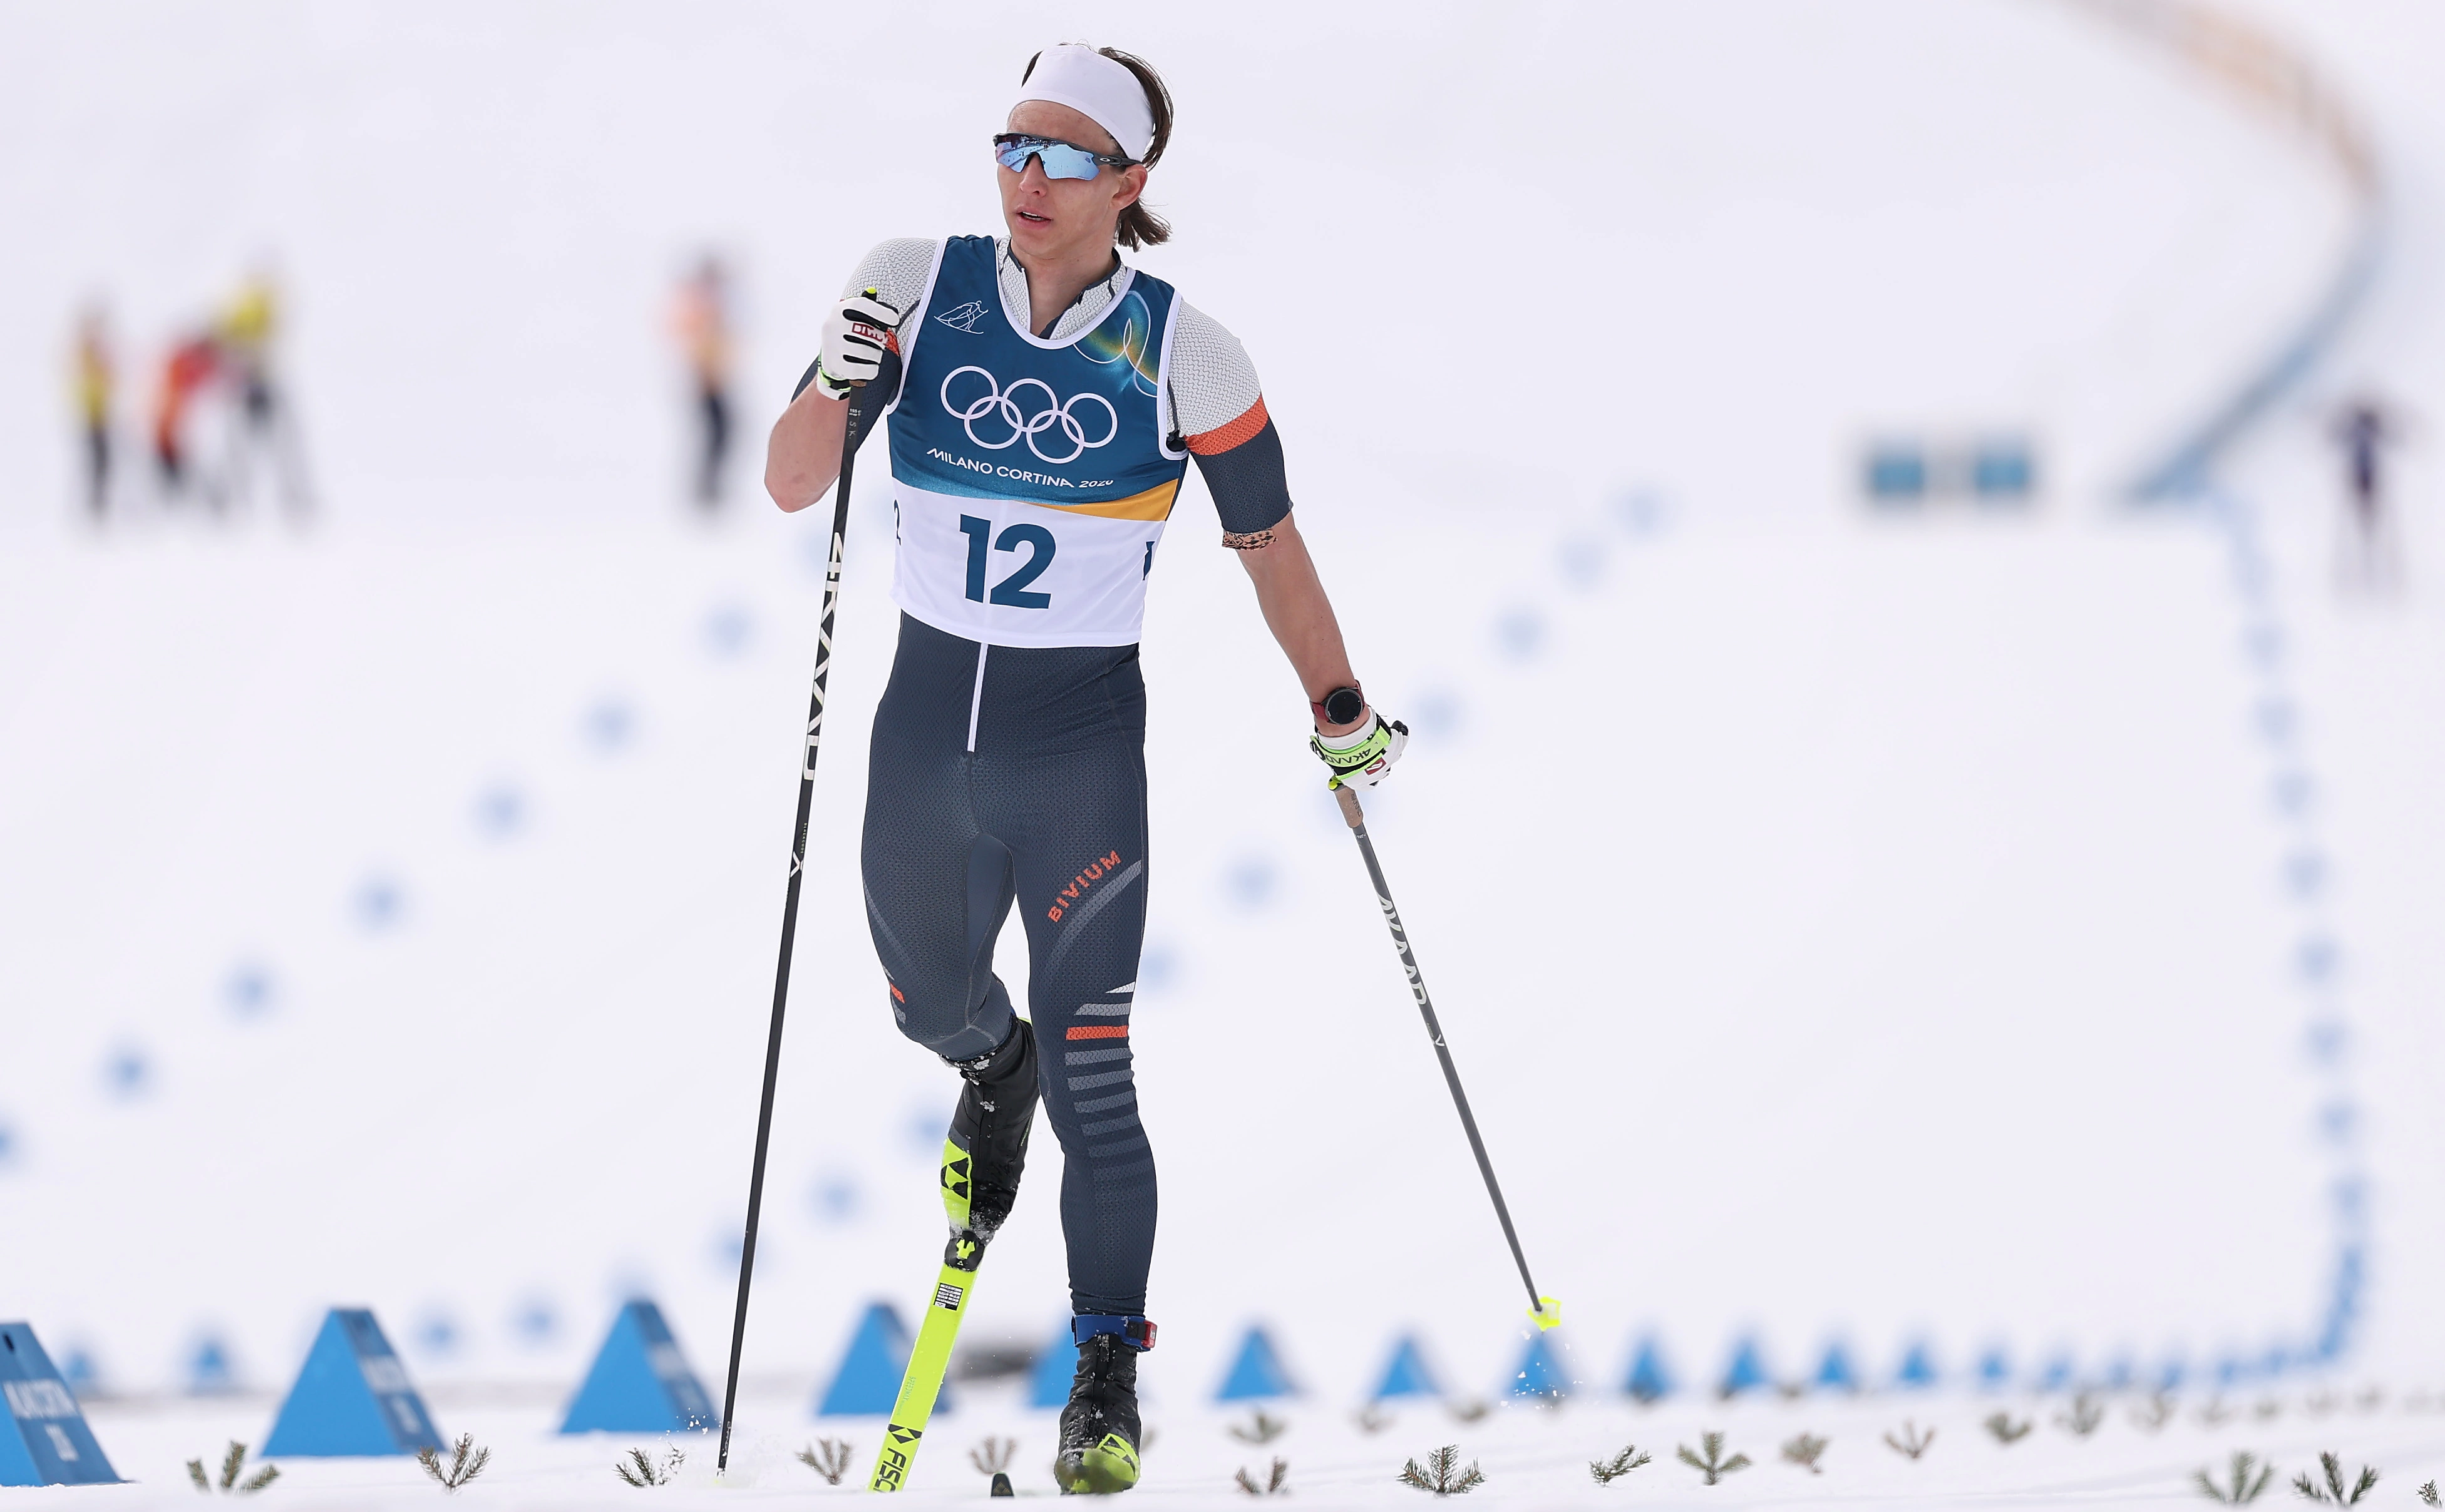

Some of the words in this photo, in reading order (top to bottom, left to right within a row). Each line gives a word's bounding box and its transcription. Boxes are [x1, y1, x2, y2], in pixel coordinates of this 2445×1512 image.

[927, 448, 993, 474] MILANO
[996, 466, 1075, 488] CORTINA
[959, 513, 1057, 609] 12
[1047, 850, 1121, 922] BIVIUM
[873, 1448, 907, 1493] FISC
